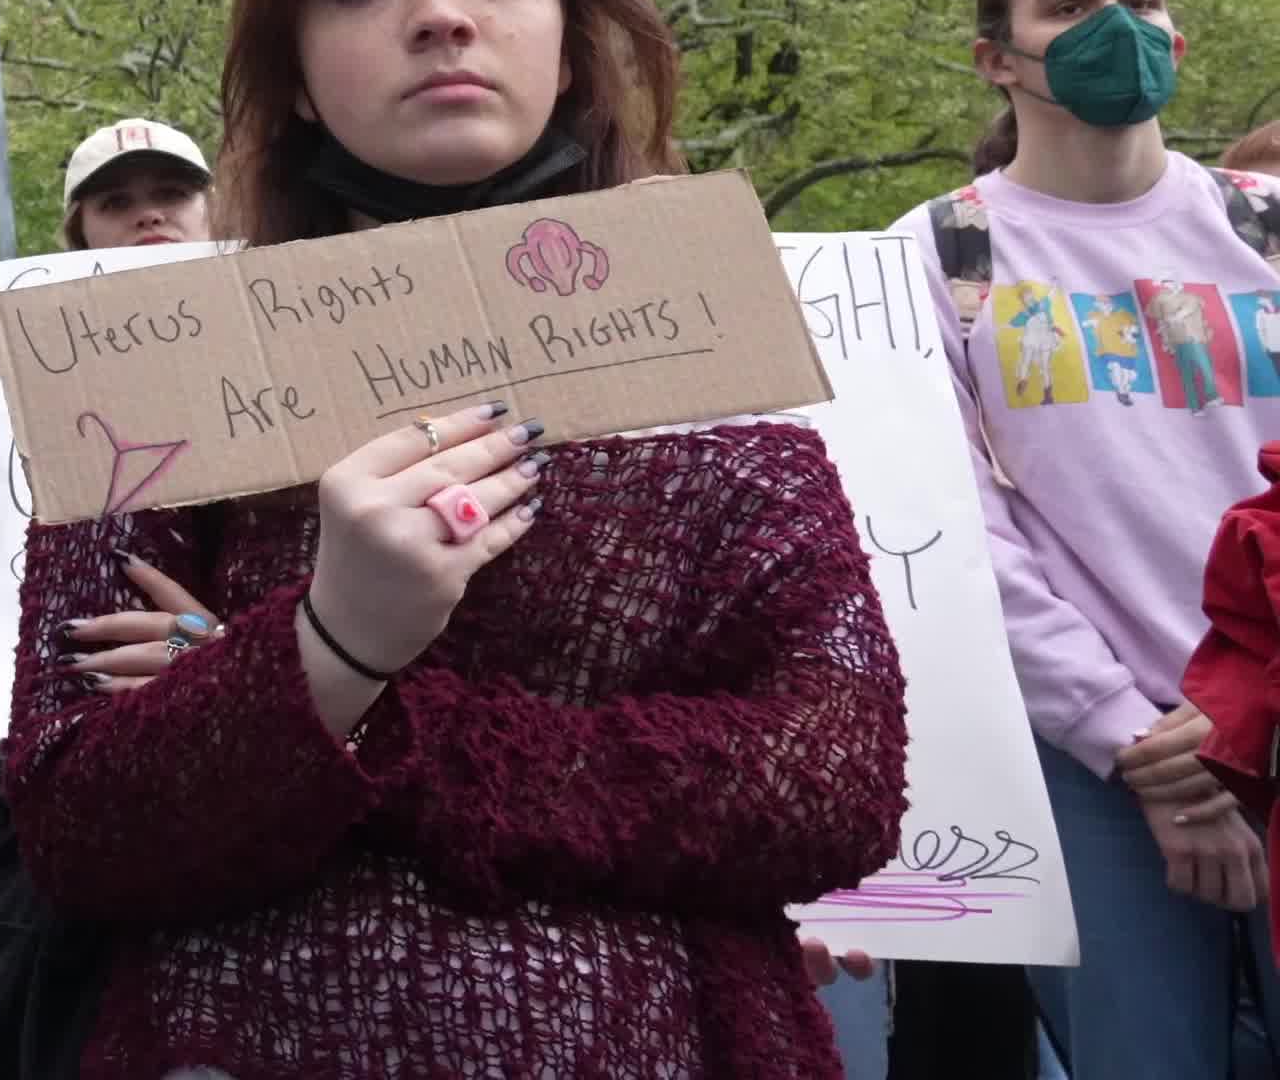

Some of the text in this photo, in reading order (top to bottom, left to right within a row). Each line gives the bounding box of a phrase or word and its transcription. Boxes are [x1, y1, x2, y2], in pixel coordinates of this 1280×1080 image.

[16, 264, 414, 374] Uterus Rights
[777, 237, 933, 360] GHT,
[219, 374, 315, 438] Are
[354, 336, 511, 412] HUMAN
